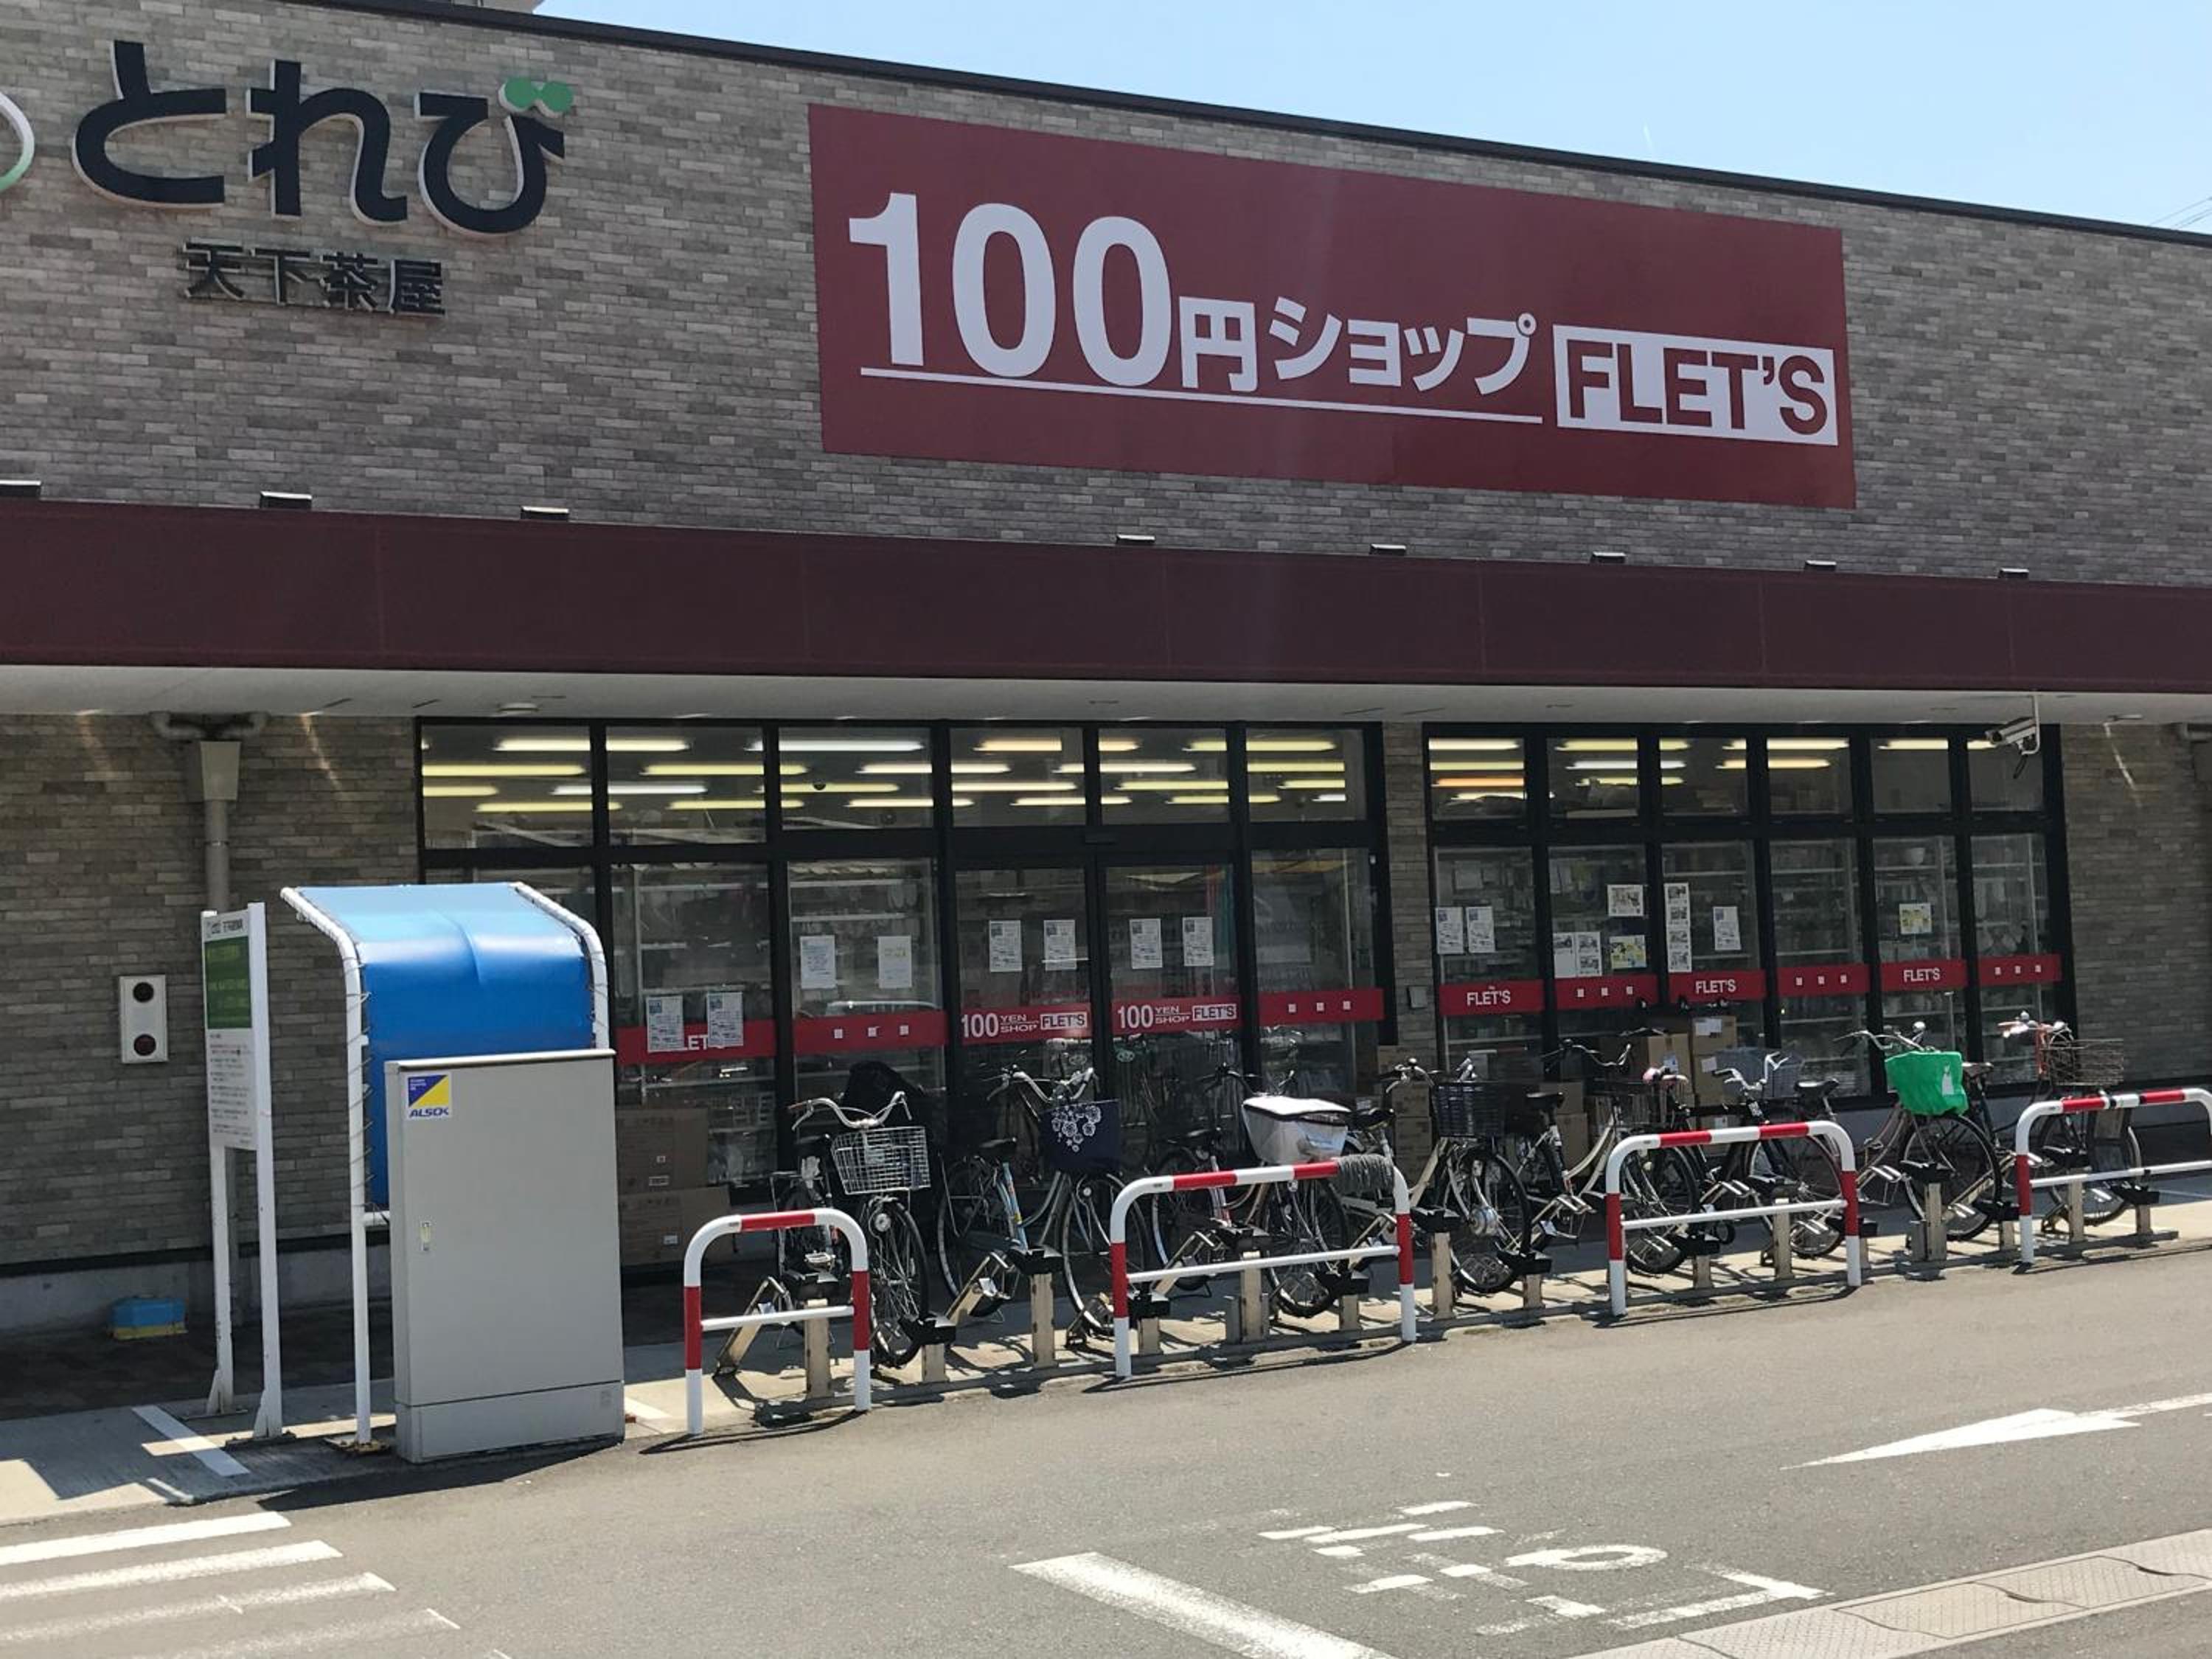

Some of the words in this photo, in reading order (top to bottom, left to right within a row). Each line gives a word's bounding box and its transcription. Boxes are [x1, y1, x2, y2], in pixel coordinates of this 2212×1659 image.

[72, 39, 574, 237] とれび
[179, 240, 445, 314] 天下茶屋
[1567, 339, 1829, 435] FLET'S
[1694, 978, 1737, 995] FLET'S
[1466, 989, 1512, 1006] FLET'S
[1000, 1014, 1027, 1023] YEN
[1117, 1004, 1154, 1029] 100
[1155, 1005, 1180, 1015] YEN
[1193, 1005, 1236, 1020] FLET'S
[961, 1013, 999, 1037] 100
[1000, 1023, 1038, 1033] SHOP
[1042, 1014, 1086, 1029] FLET'S
[1155, 1015, 1190, 1024] SHOP
